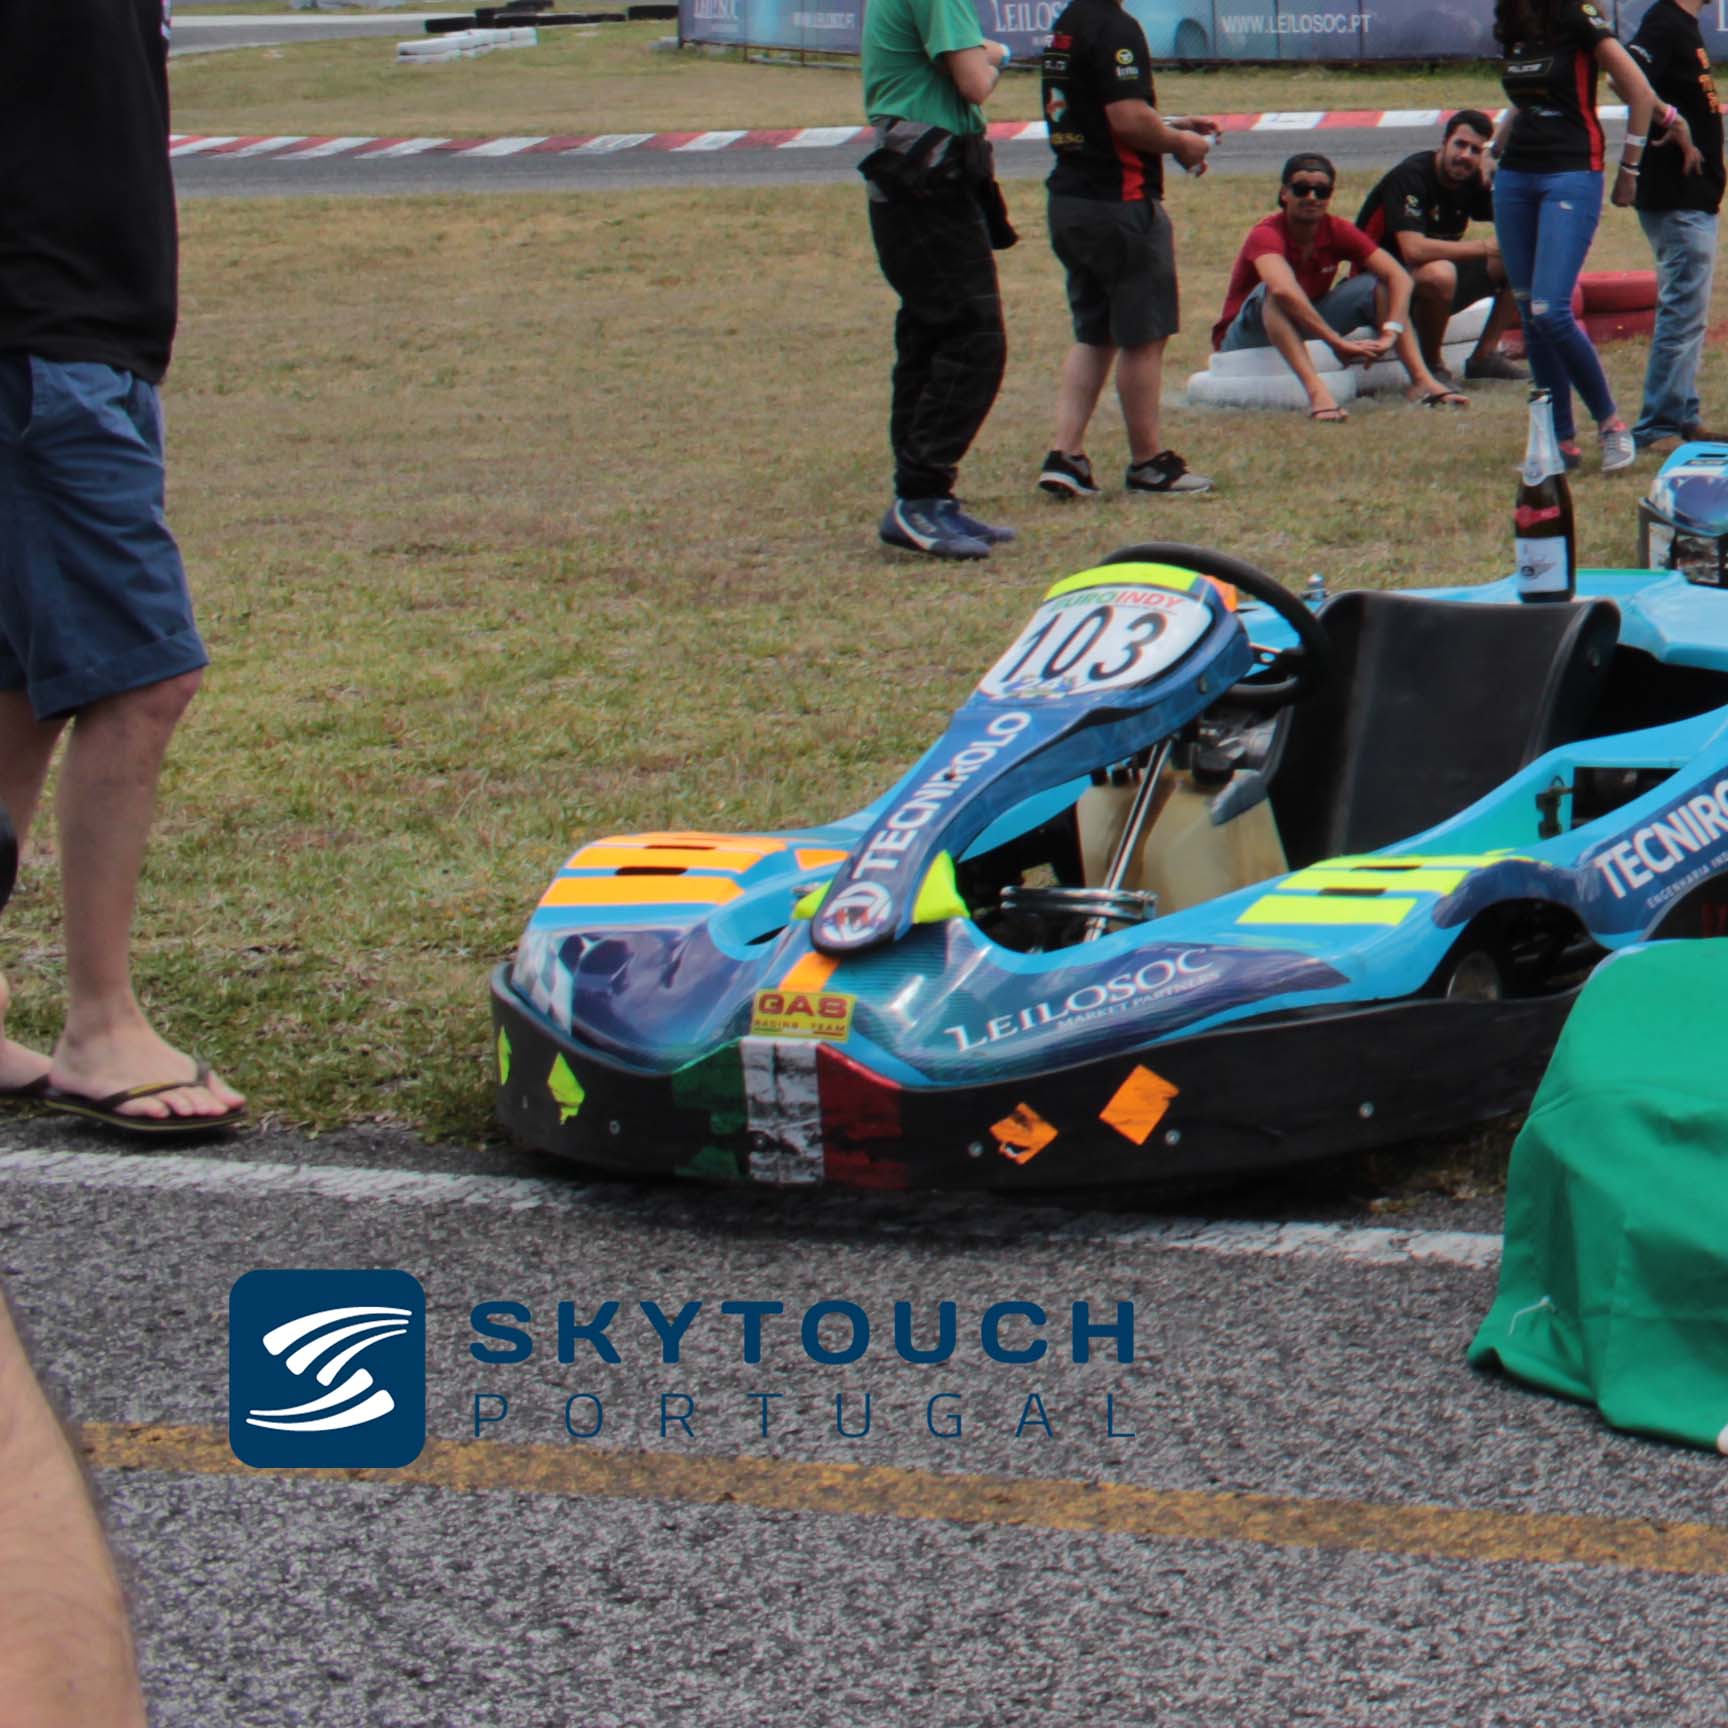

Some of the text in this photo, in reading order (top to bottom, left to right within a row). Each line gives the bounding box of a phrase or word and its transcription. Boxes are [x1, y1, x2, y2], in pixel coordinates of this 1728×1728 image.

[1221, 13, 1371, 34] WWW.LEILOSOC.PT
[1000, 605, 1168, 682] 103
[944, 948, 1214, 1052] LEILOSOC
